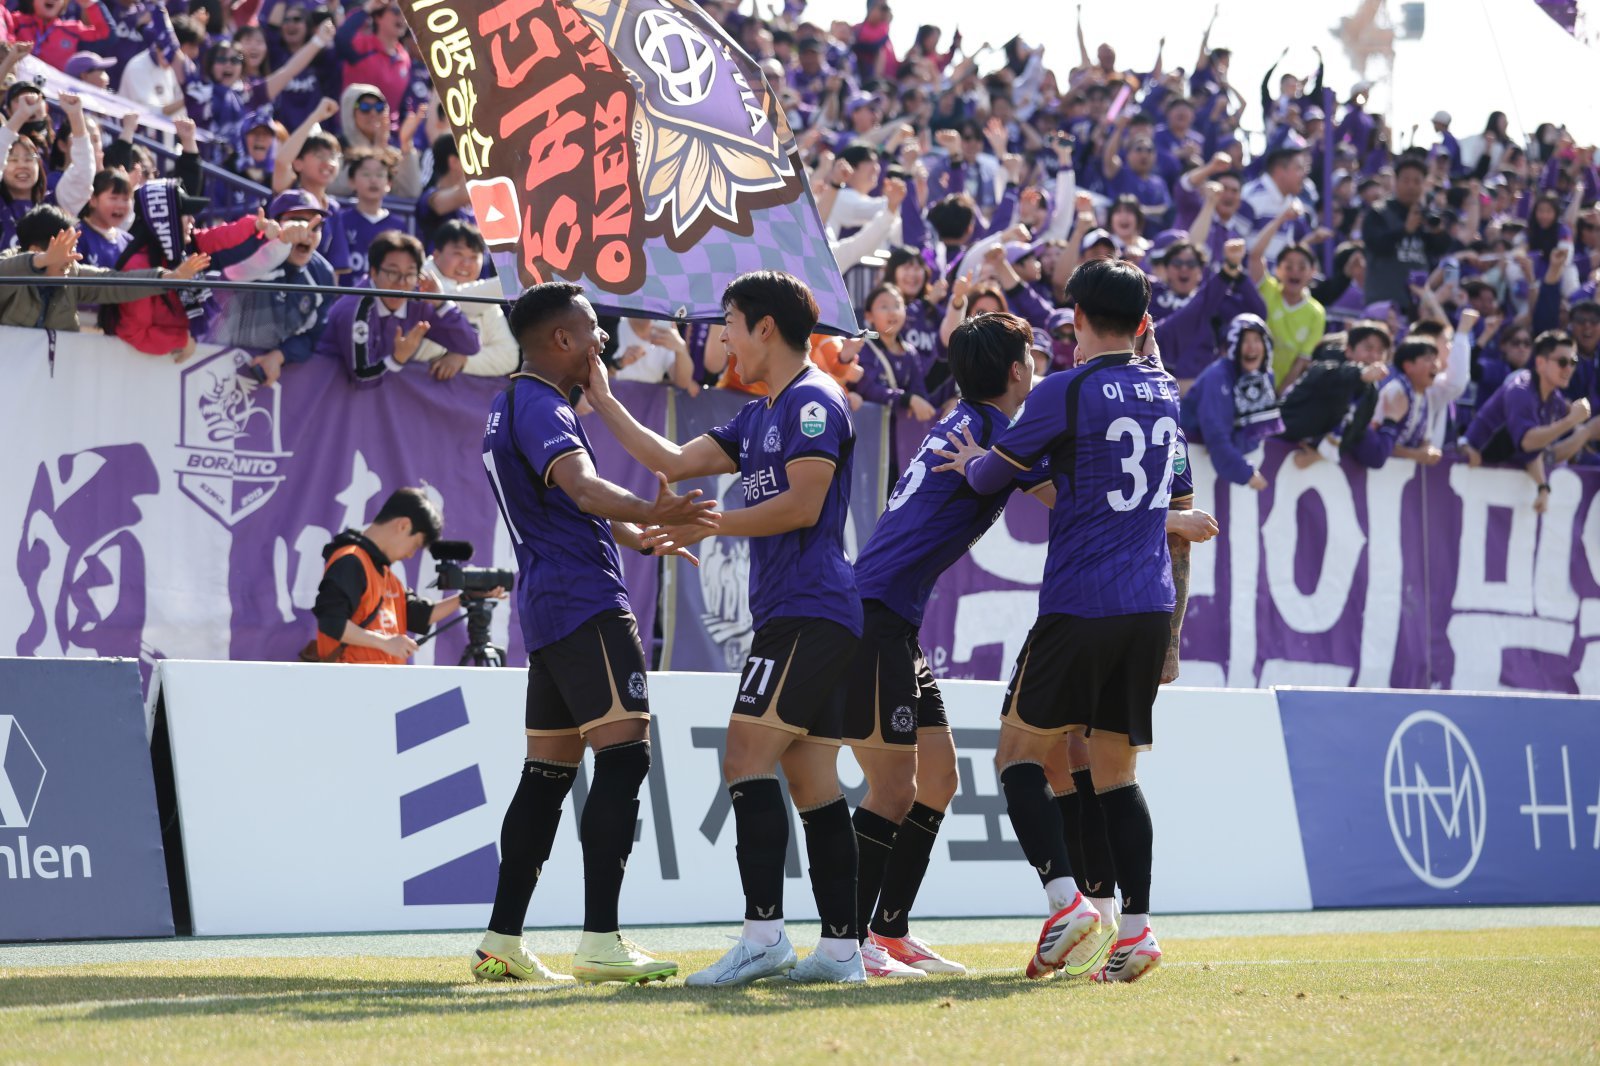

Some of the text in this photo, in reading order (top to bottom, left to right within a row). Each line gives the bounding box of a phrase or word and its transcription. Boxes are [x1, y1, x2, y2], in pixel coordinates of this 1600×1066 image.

[187, 454, 277, 475] BORANTO
[1105, 416, 1178, 512] 32
[741, 656, 775, 696] 71
